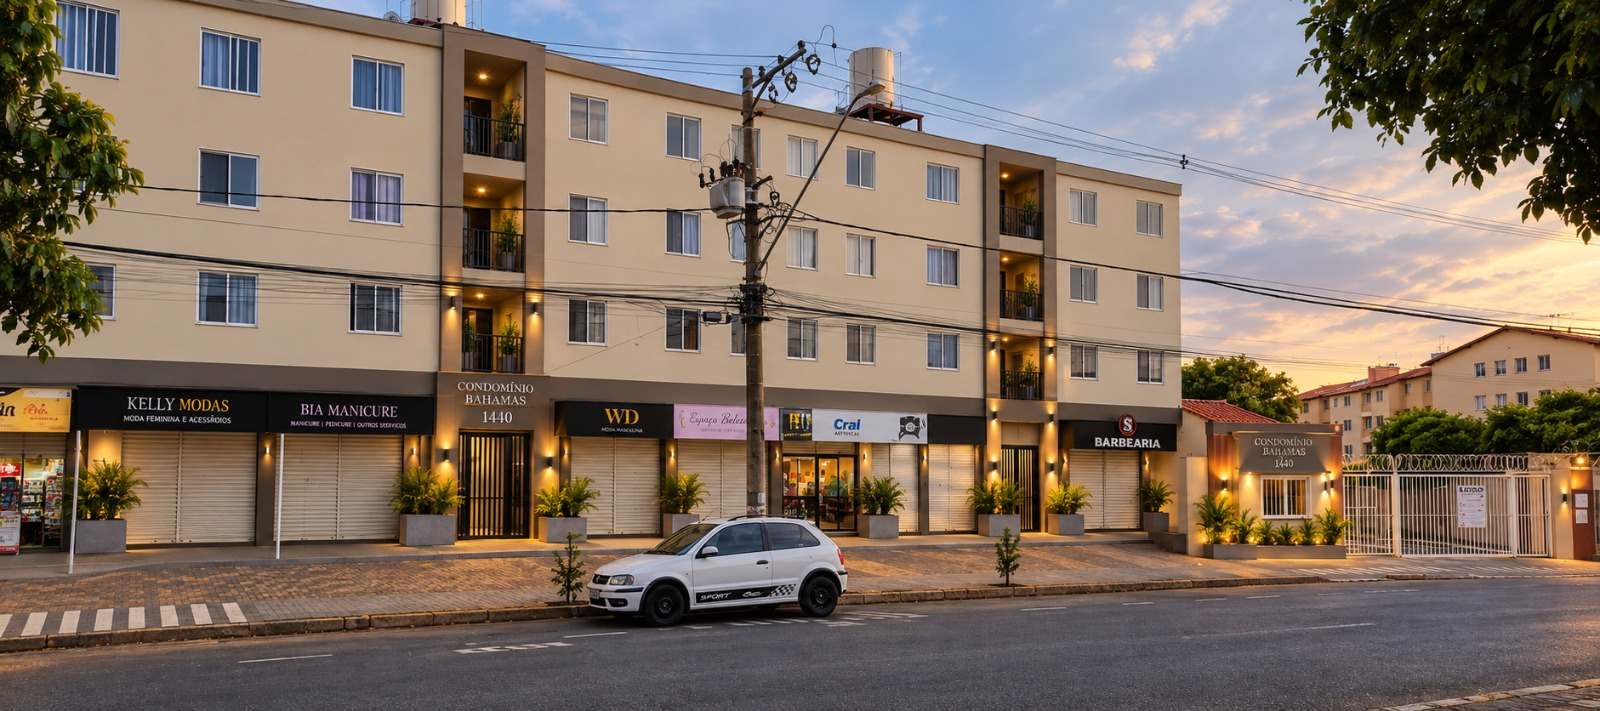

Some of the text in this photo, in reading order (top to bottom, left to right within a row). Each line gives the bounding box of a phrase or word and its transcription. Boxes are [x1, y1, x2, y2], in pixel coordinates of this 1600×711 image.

[457, 381, 534, 394] CONDOMÍNIO
[127, 396, 229, 412] KELLY MODAS
[465, 394, 527, 405] BAHAMAS
[300, 403, 398, 418] BIA MANICURE
[482, 410, 513, 424] 1440
[604, 408, 640, 425] WD
[146, 415, 180, 423] FEMININA
[1123, 416, 1133, 432] S
[1094, 436, 1161, 449] BARBEARIA
[1254, 435, 1313, 446] CONDOMÍNIO
[1263, 447, 1306, 456] BAHAMAS
[700, 592, 732, 600] SPORT
